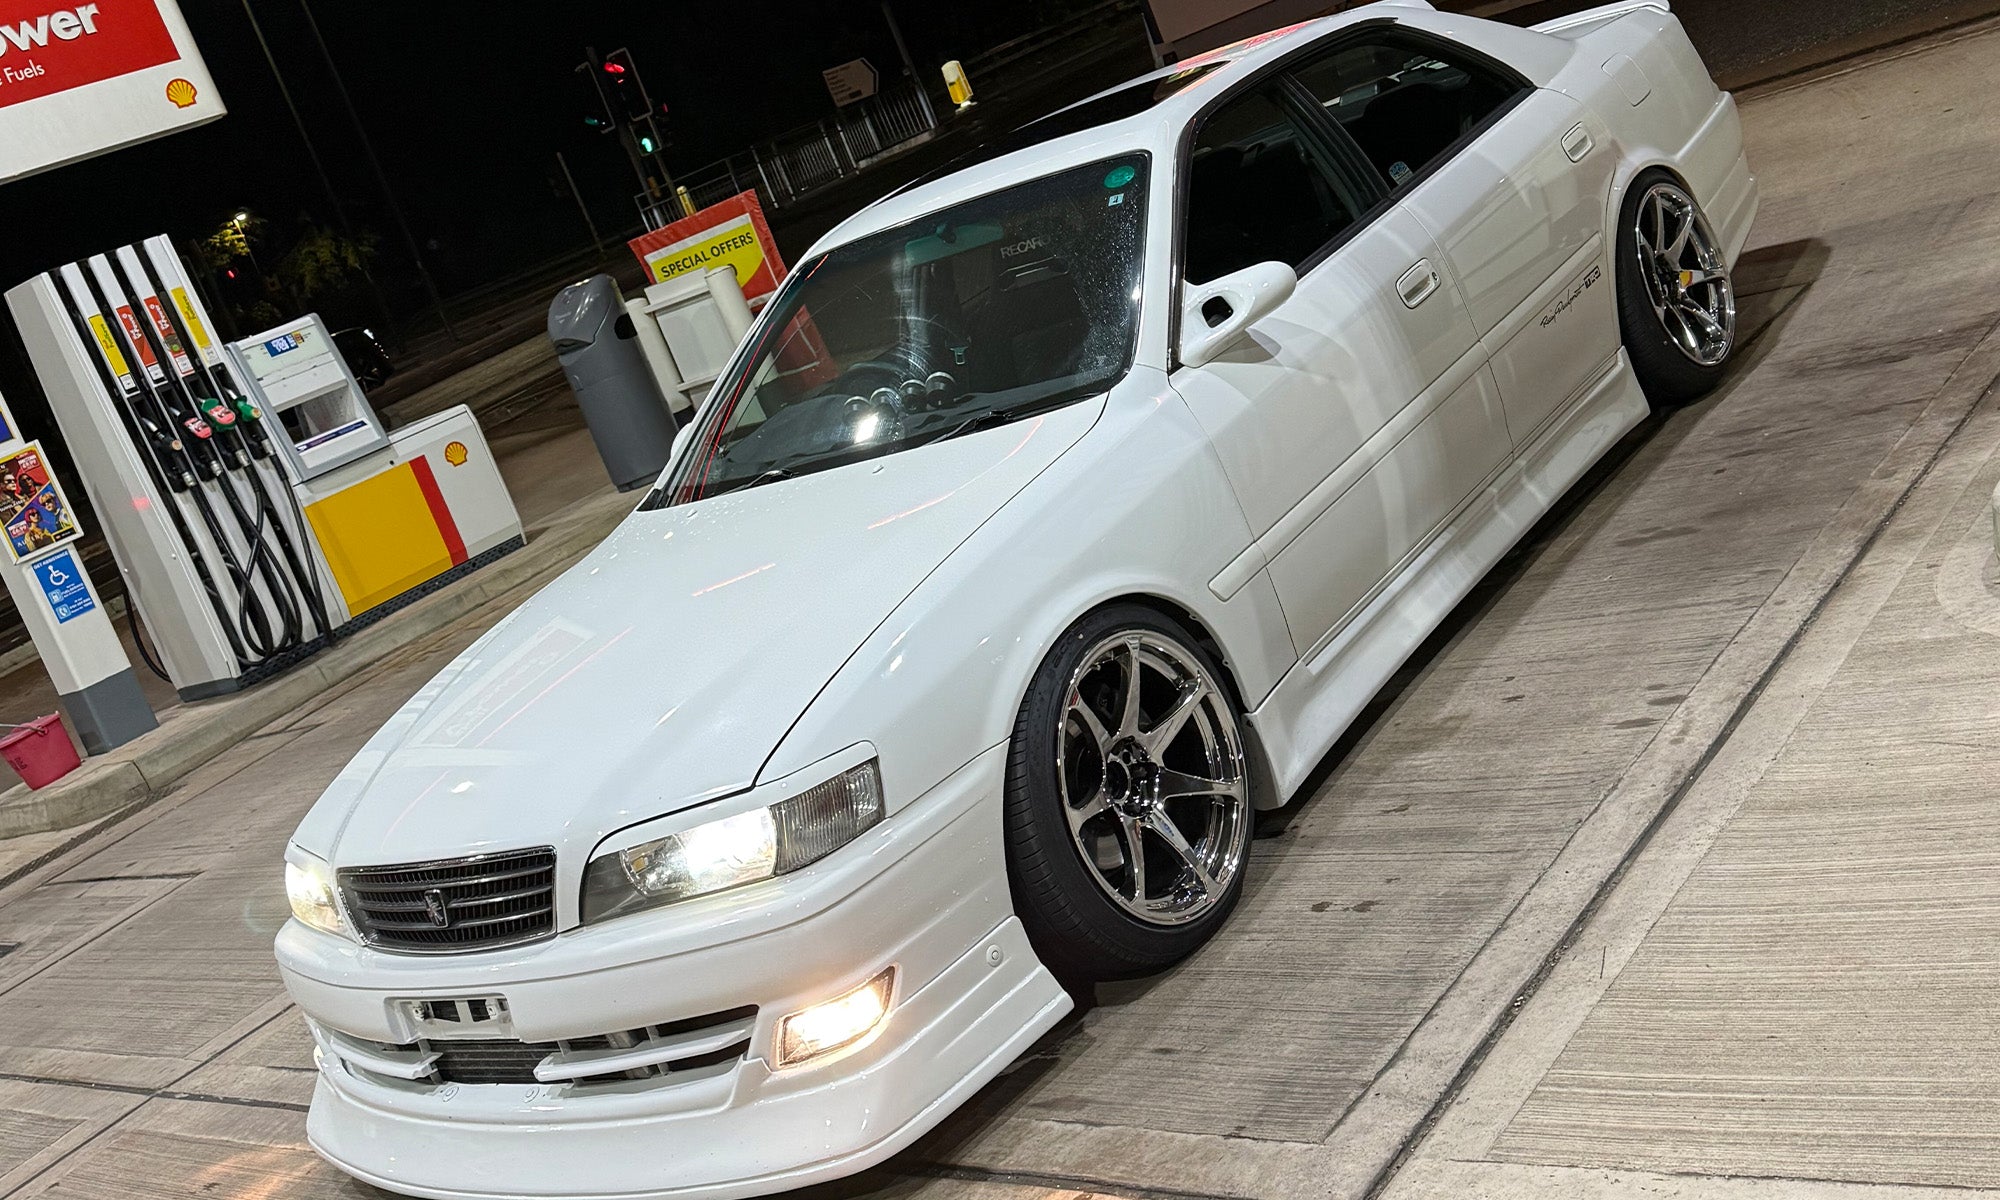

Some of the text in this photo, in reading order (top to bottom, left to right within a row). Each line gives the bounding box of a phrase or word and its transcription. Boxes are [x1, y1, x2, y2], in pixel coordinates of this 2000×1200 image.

[3, 59, 45, 83] Fuels
[661, 250, 711, 277] SPECIAL
[710, 232, 754, 257] OFFERS
